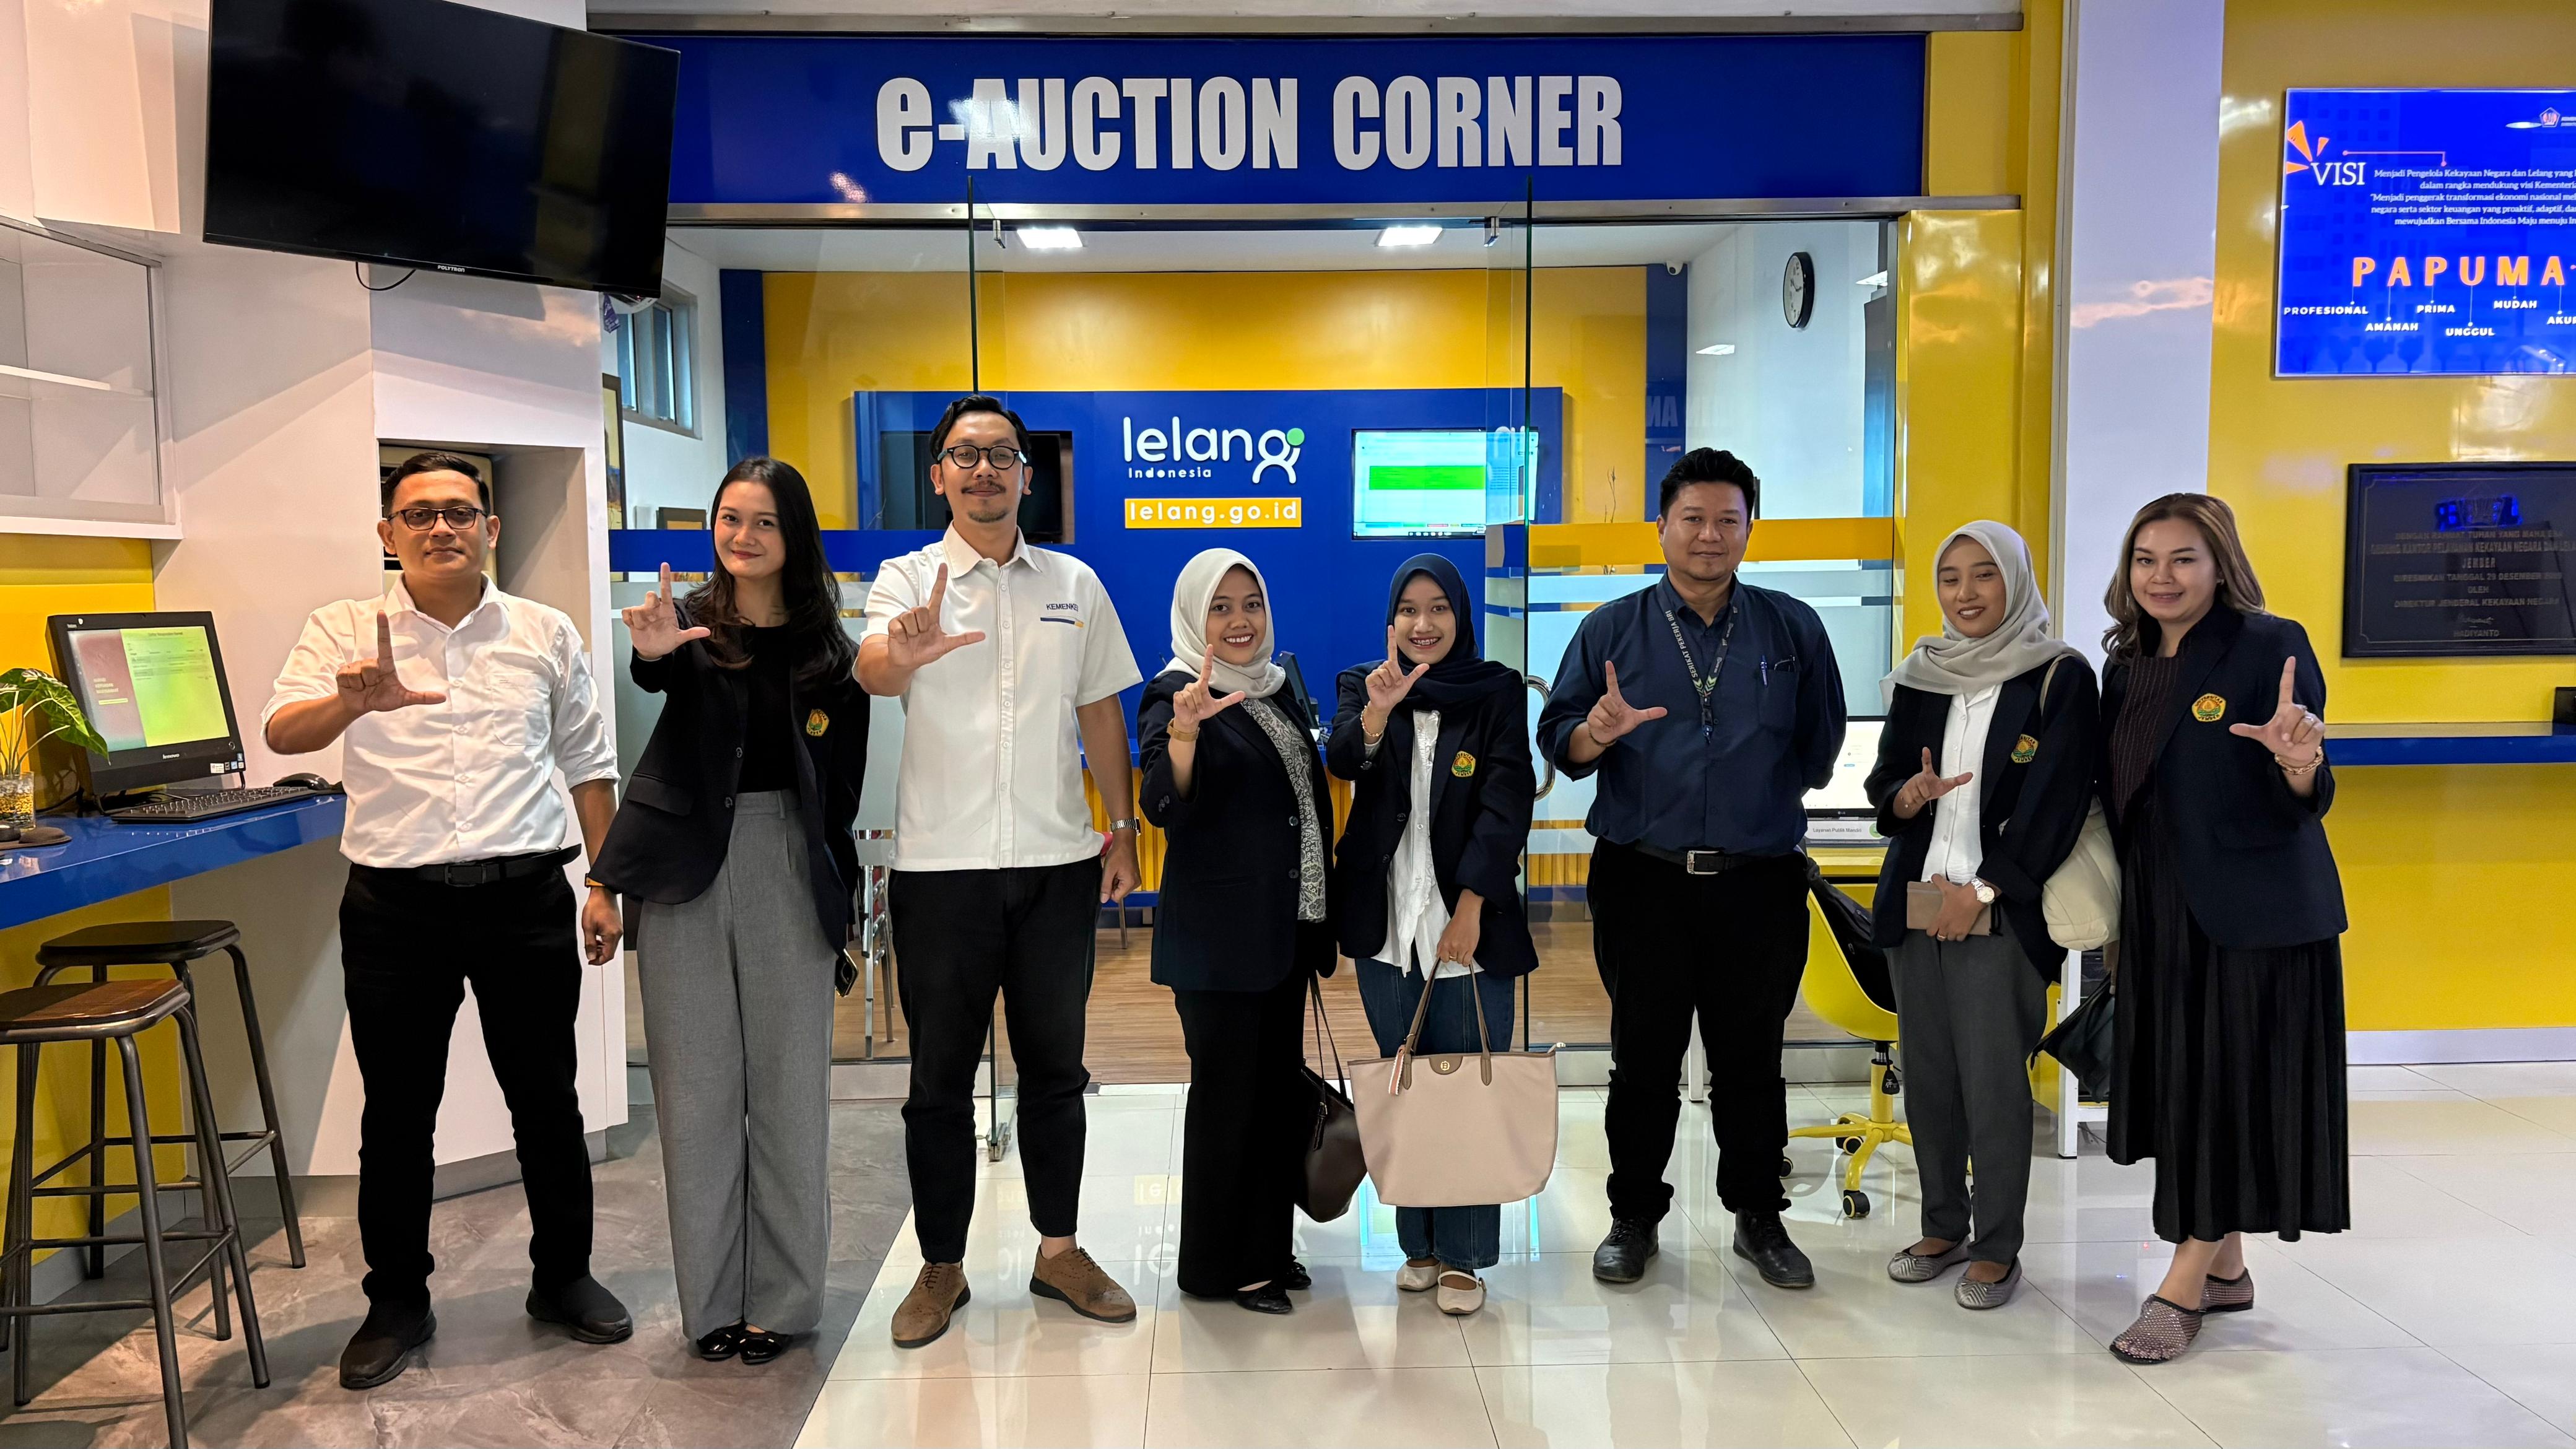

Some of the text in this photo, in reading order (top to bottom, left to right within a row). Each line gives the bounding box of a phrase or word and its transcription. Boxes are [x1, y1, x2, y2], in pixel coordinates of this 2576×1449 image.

[876, 76, 1623, 172] e-AUCTION CORNER
[2310, 162, 2366, 186] VISI
[2374, 170, 2405, 178] Menjadi
[2406, 170, 2443, 178] Pengelola
[2444, 170, 2482, 178] Kekayaan
[2483, 170, 2510, 178] Negara
[2512, 169, 2526, 177] dan
[2528, 169, 2553, 178] Lelang
[2445, 181, 2471, 190] rangka
[2473, 181, 2518, 190] mendukung
[2405, 193, 2445, 202] penggerak
[2443, 205, 2481, 214] keuangan
[2395, 217, 2445, 226] mewujudkan
[2517, 217, 2537, 225] Maju
[2539, 217, 2567, 225] menuju
[2416, 305, 2455, 313] PRIMA
[2493, 300, 2538, 309] MUDAH
[2284, 306, 2369, 315] PROFESIONAL
[2365, 323, 2419, 331] AMANAH
[2445, 328, 2496, 336] UNGGUL
[1123, 416, 1303, 484] lelang
[1128, 467, 1212, 479] Indonesia
[1130, 500, 1297, 524] lelang.go.id
[2462, 557, 2496, 568] JEMBER
[2482, 598, 2525, 606] KEKAYAAN
[1665, 610, 1699, 678] SERIKAT PEKERJA BRI
